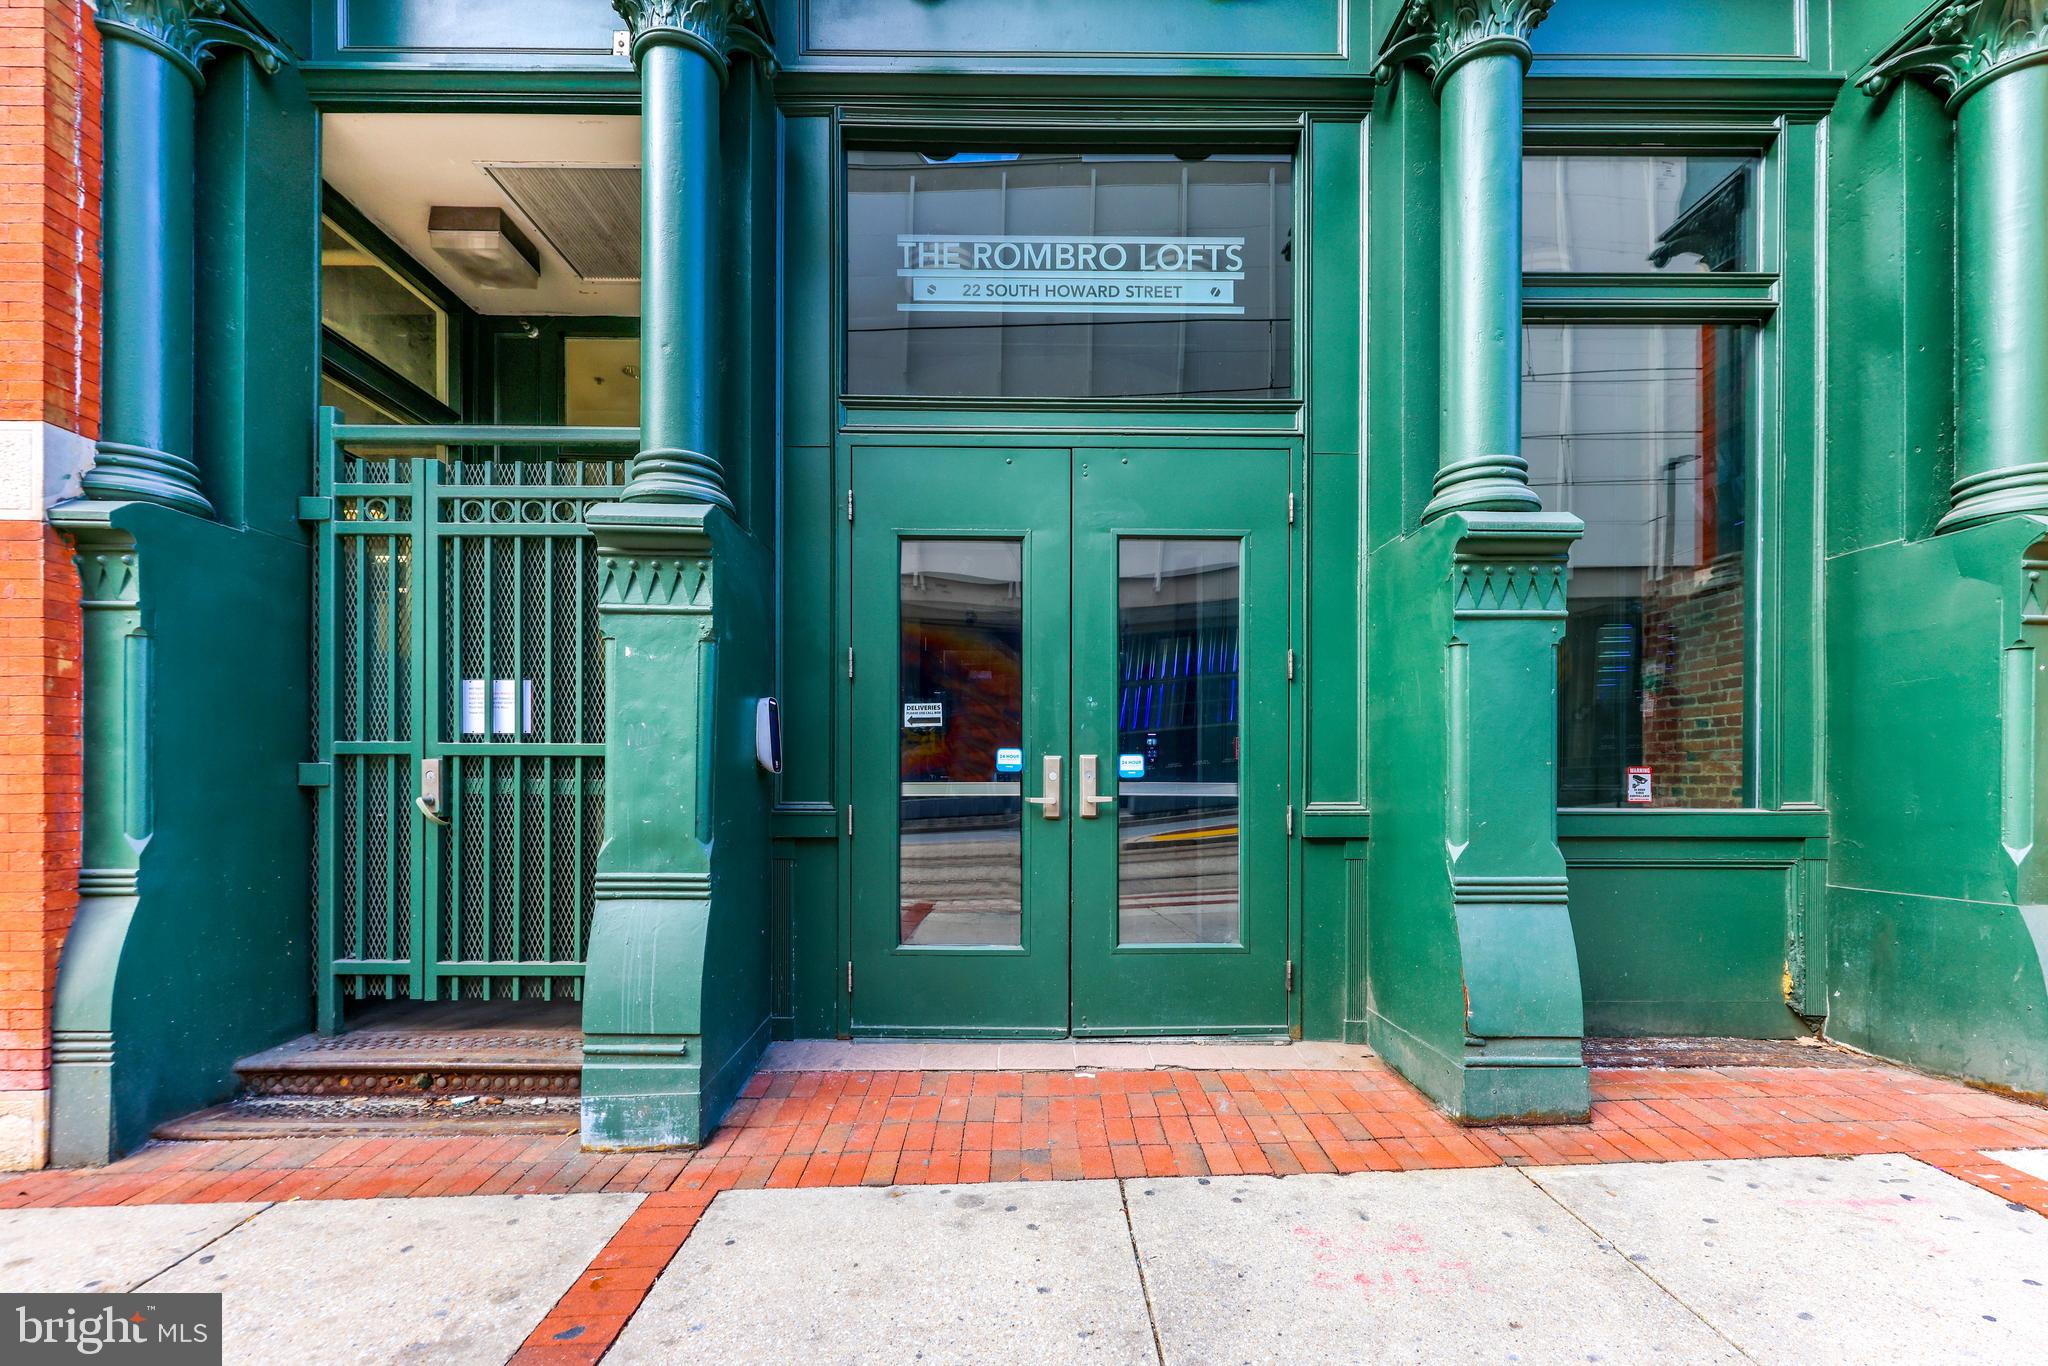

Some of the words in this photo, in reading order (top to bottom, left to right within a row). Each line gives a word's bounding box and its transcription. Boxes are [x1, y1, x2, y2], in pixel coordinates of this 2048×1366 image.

[898, 242, 961, 269] THE
[973, 242, 1127, 271] ROMBRO
[1140, 243, 1243, 272] LOFTS
[962, 284, 981, 297] 22
[986, 284, 1040, 298] SOUTH
[1045, 284, 1120, 298] HOWARD
[1125, 285, 1183, 299] STREET
